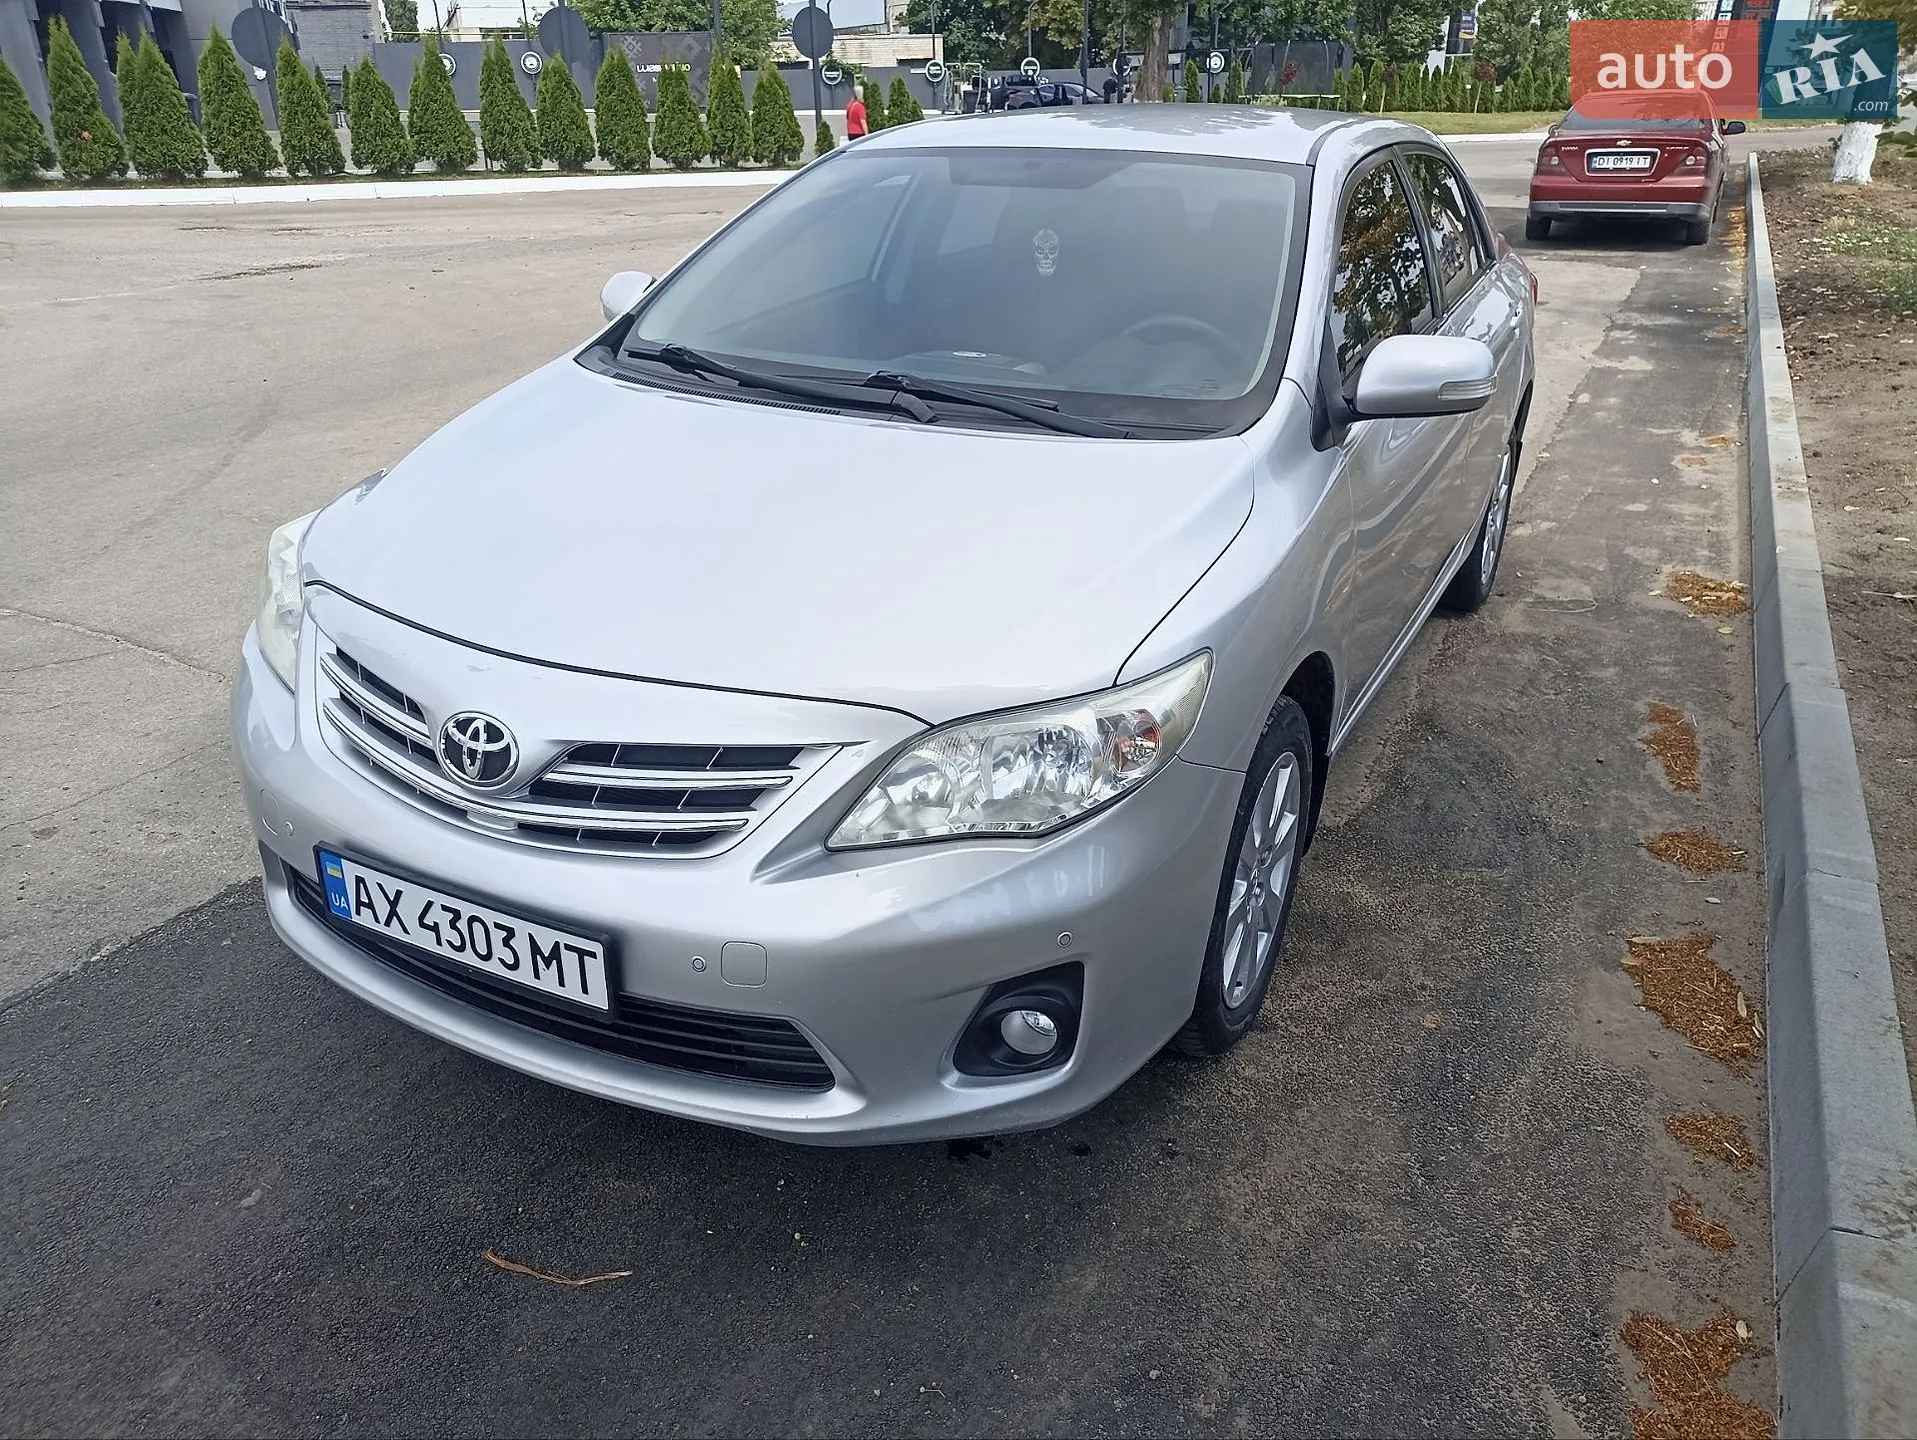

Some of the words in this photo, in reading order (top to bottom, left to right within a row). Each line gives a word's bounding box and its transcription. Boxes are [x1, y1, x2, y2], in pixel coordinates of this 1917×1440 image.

[331, 891, 348, 910] UA
[354, 874, 411, 936] AX
[418, 899, 520, 972] 4303
[528, 931, 597, 996] MT
